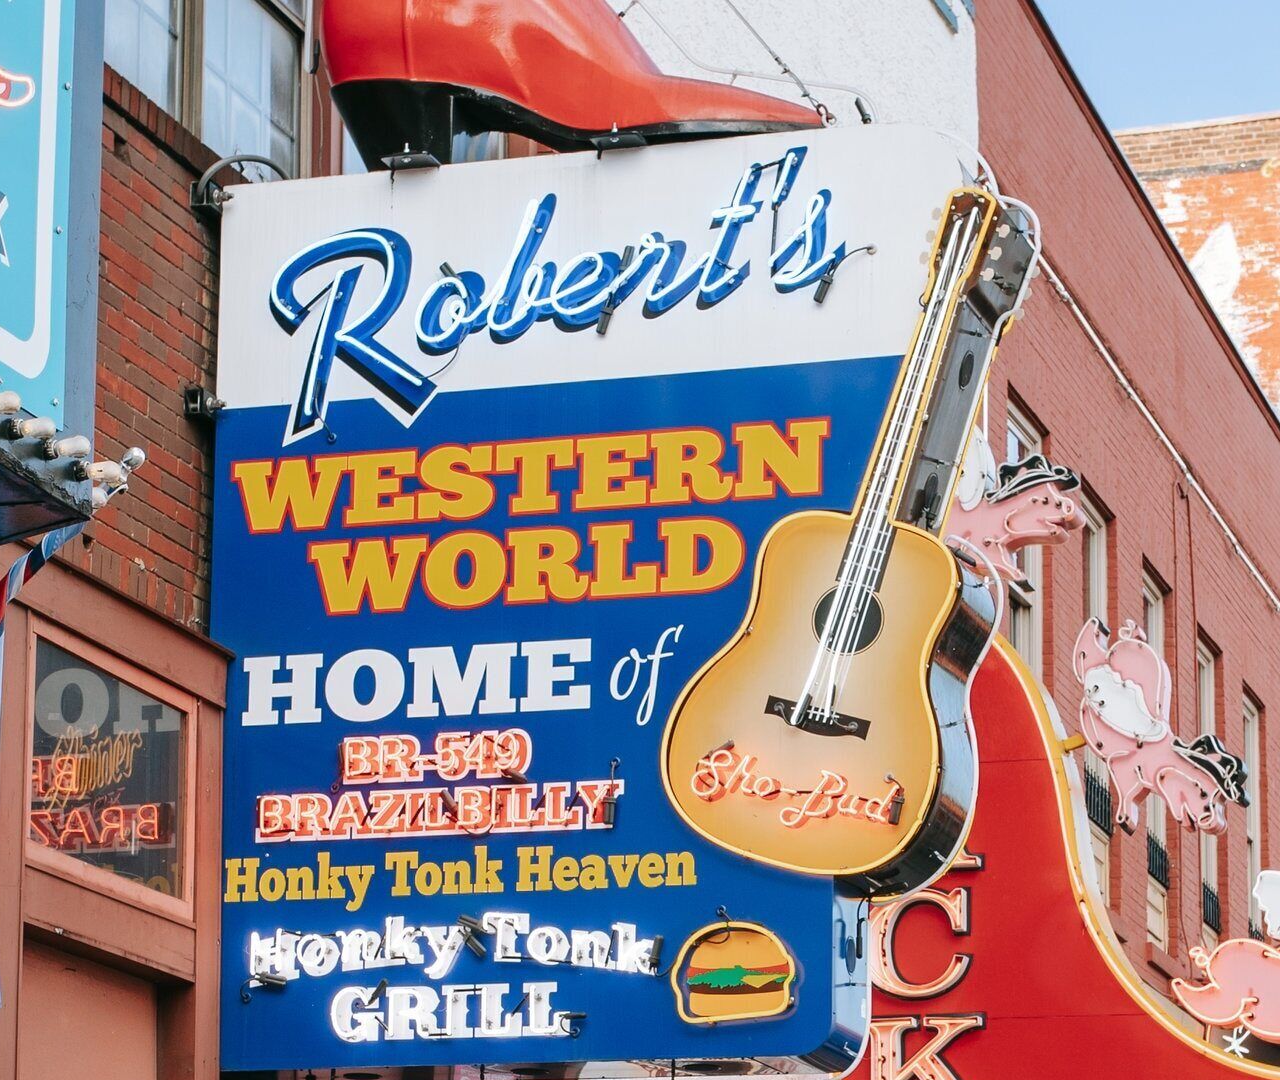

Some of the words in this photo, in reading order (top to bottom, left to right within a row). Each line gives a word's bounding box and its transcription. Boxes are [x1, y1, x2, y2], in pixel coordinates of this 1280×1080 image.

[270, 146, 848, 441] Robert's
[234, 416, 831, 534] WESTERN
[309, 515, 746, 617] WORLD
[242, 638, 593, 727] HOME
[609, 624, 684, 726] of
[340, 728, 532, 785] BR-549
[690, 745, 905, 829] Sho-Bud
[255, 779, 624, 844] BRAZILBILLY
[224, 851, 375, 911] Honky
[385, 845, 502, 898] Tonk
[516, 844, 698, 893] Heaven
[251, 914, 471, 982] Honky
[481, 911, 661, 976] Tonk
[329, 981, 569, 1044] GRILL
